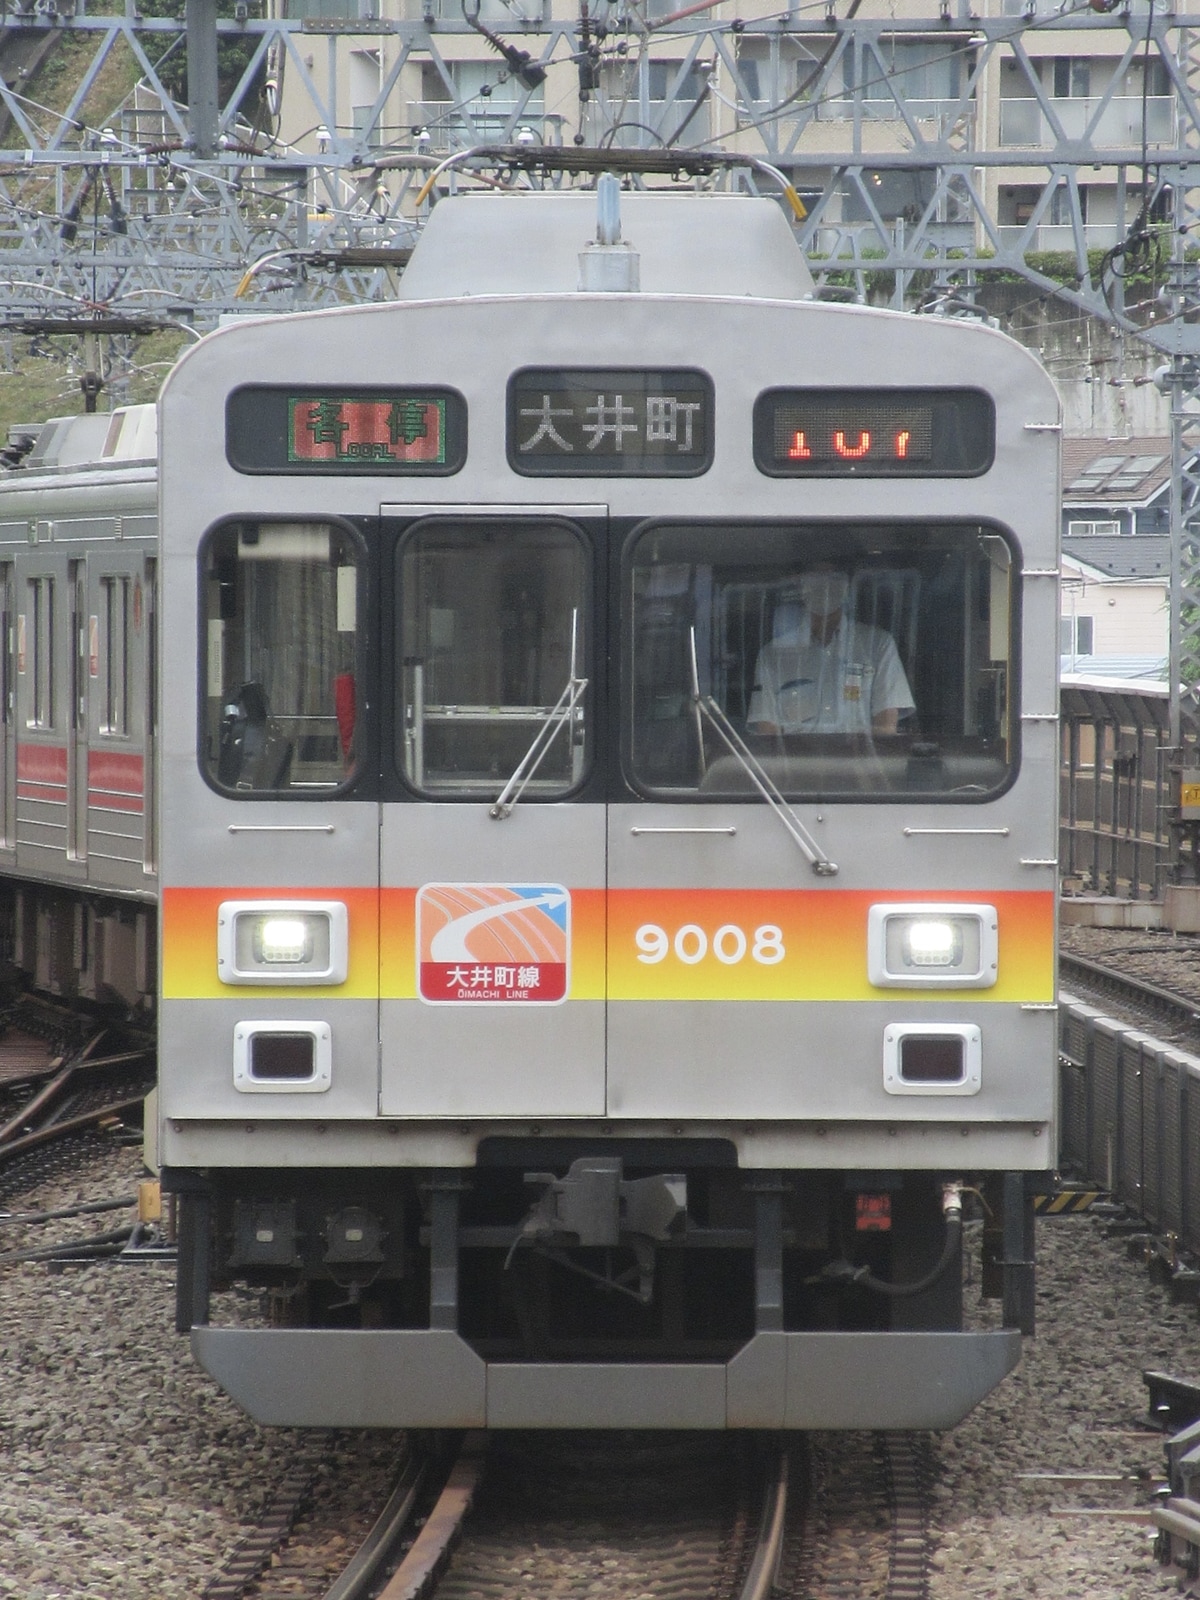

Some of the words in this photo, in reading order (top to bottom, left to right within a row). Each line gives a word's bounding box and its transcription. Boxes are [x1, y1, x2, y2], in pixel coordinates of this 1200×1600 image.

[306, 401, 428, 444] 各停
[519, 394, 700, 451] 大井町
[337, 441, 396, 457] LOCAL
[635, 923, 786, 965] 9008
[446, 966, 540, 989] 大井町線
[506, 990, 529, 999] LINE
